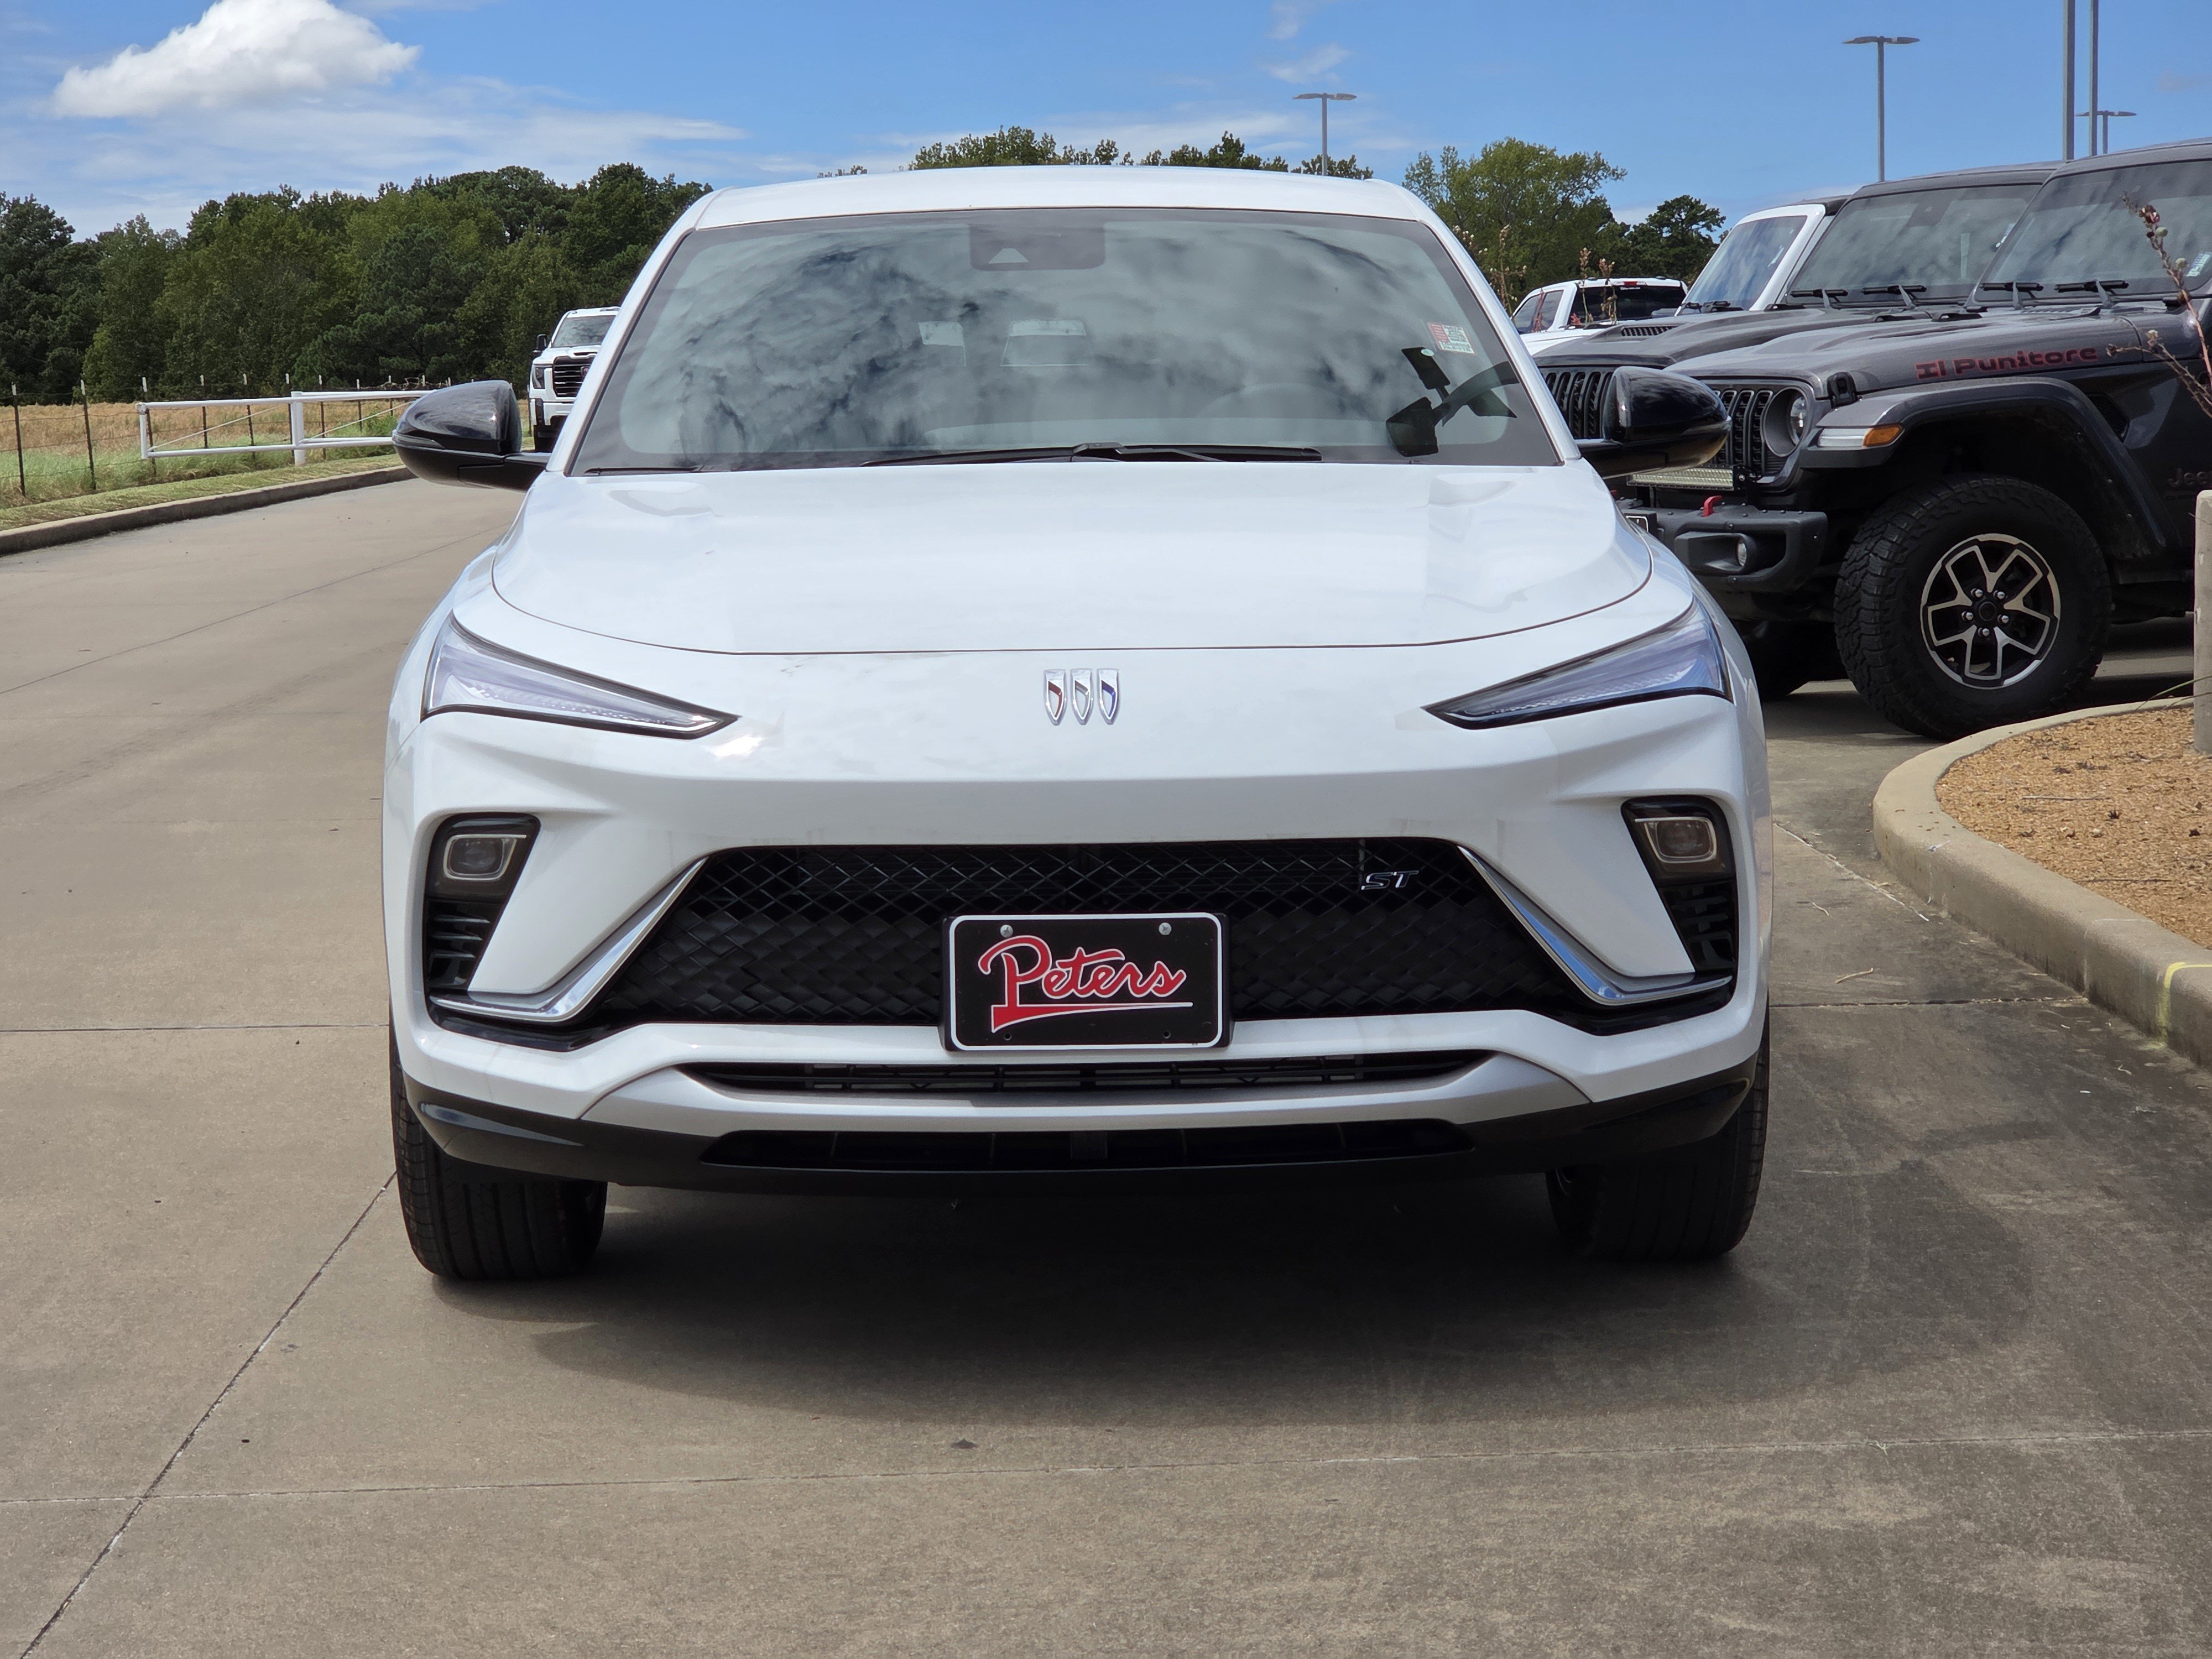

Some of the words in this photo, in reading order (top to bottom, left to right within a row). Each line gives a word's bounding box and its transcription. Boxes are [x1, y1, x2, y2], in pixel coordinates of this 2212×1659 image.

[1953, 347, 2098, 374] Punitore
[2168, 468, 2212, 488] Jee
[1361, 870, 1419, 890] ST
[978, 935, 1187, 1008] Peters
